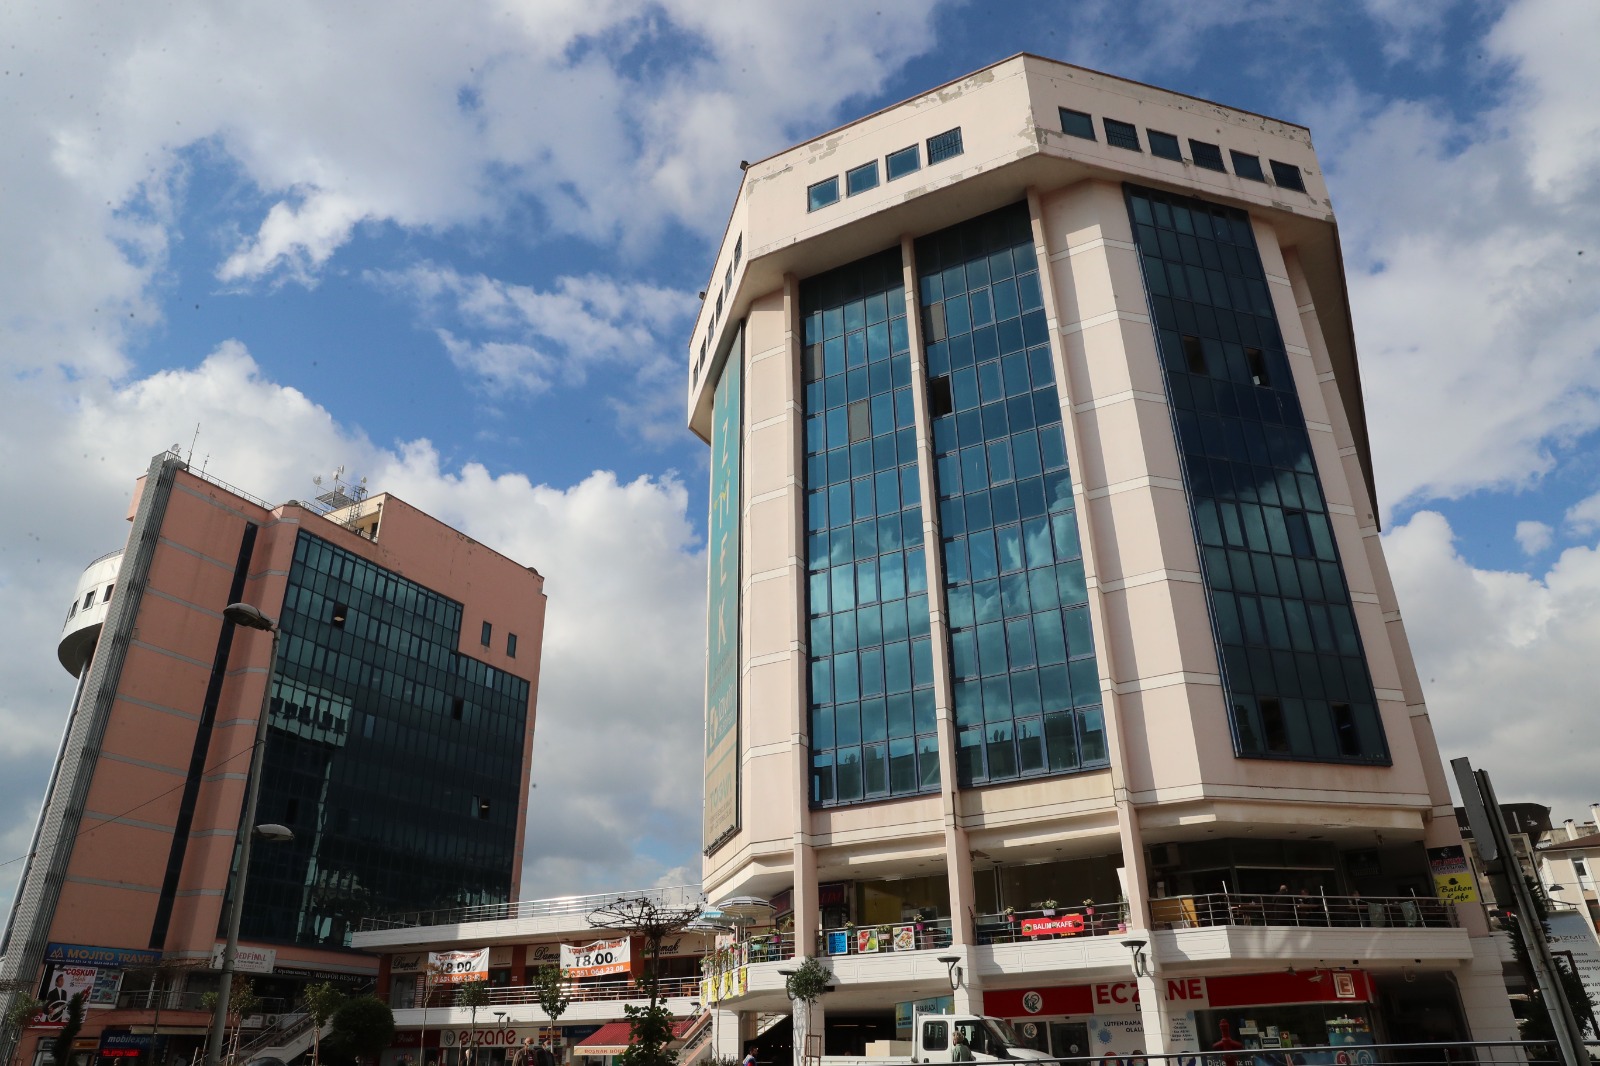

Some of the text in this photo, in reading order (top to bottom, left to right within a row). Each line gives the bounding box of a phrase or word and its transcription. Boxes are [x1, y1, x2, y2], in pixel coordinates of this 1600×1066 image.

[1056, 920, 1073, 928] KAFE
[645, 938, 681, 952] Dmak
[67, 949, 155, 963] MOJITO TRAVEL
[534, 946, 560, 962] Dama
[575, 952, 613, 967] 18.00
[1096, 979, 1204, 1004] ECZNE
[1339, 978, 1351, 993] E
